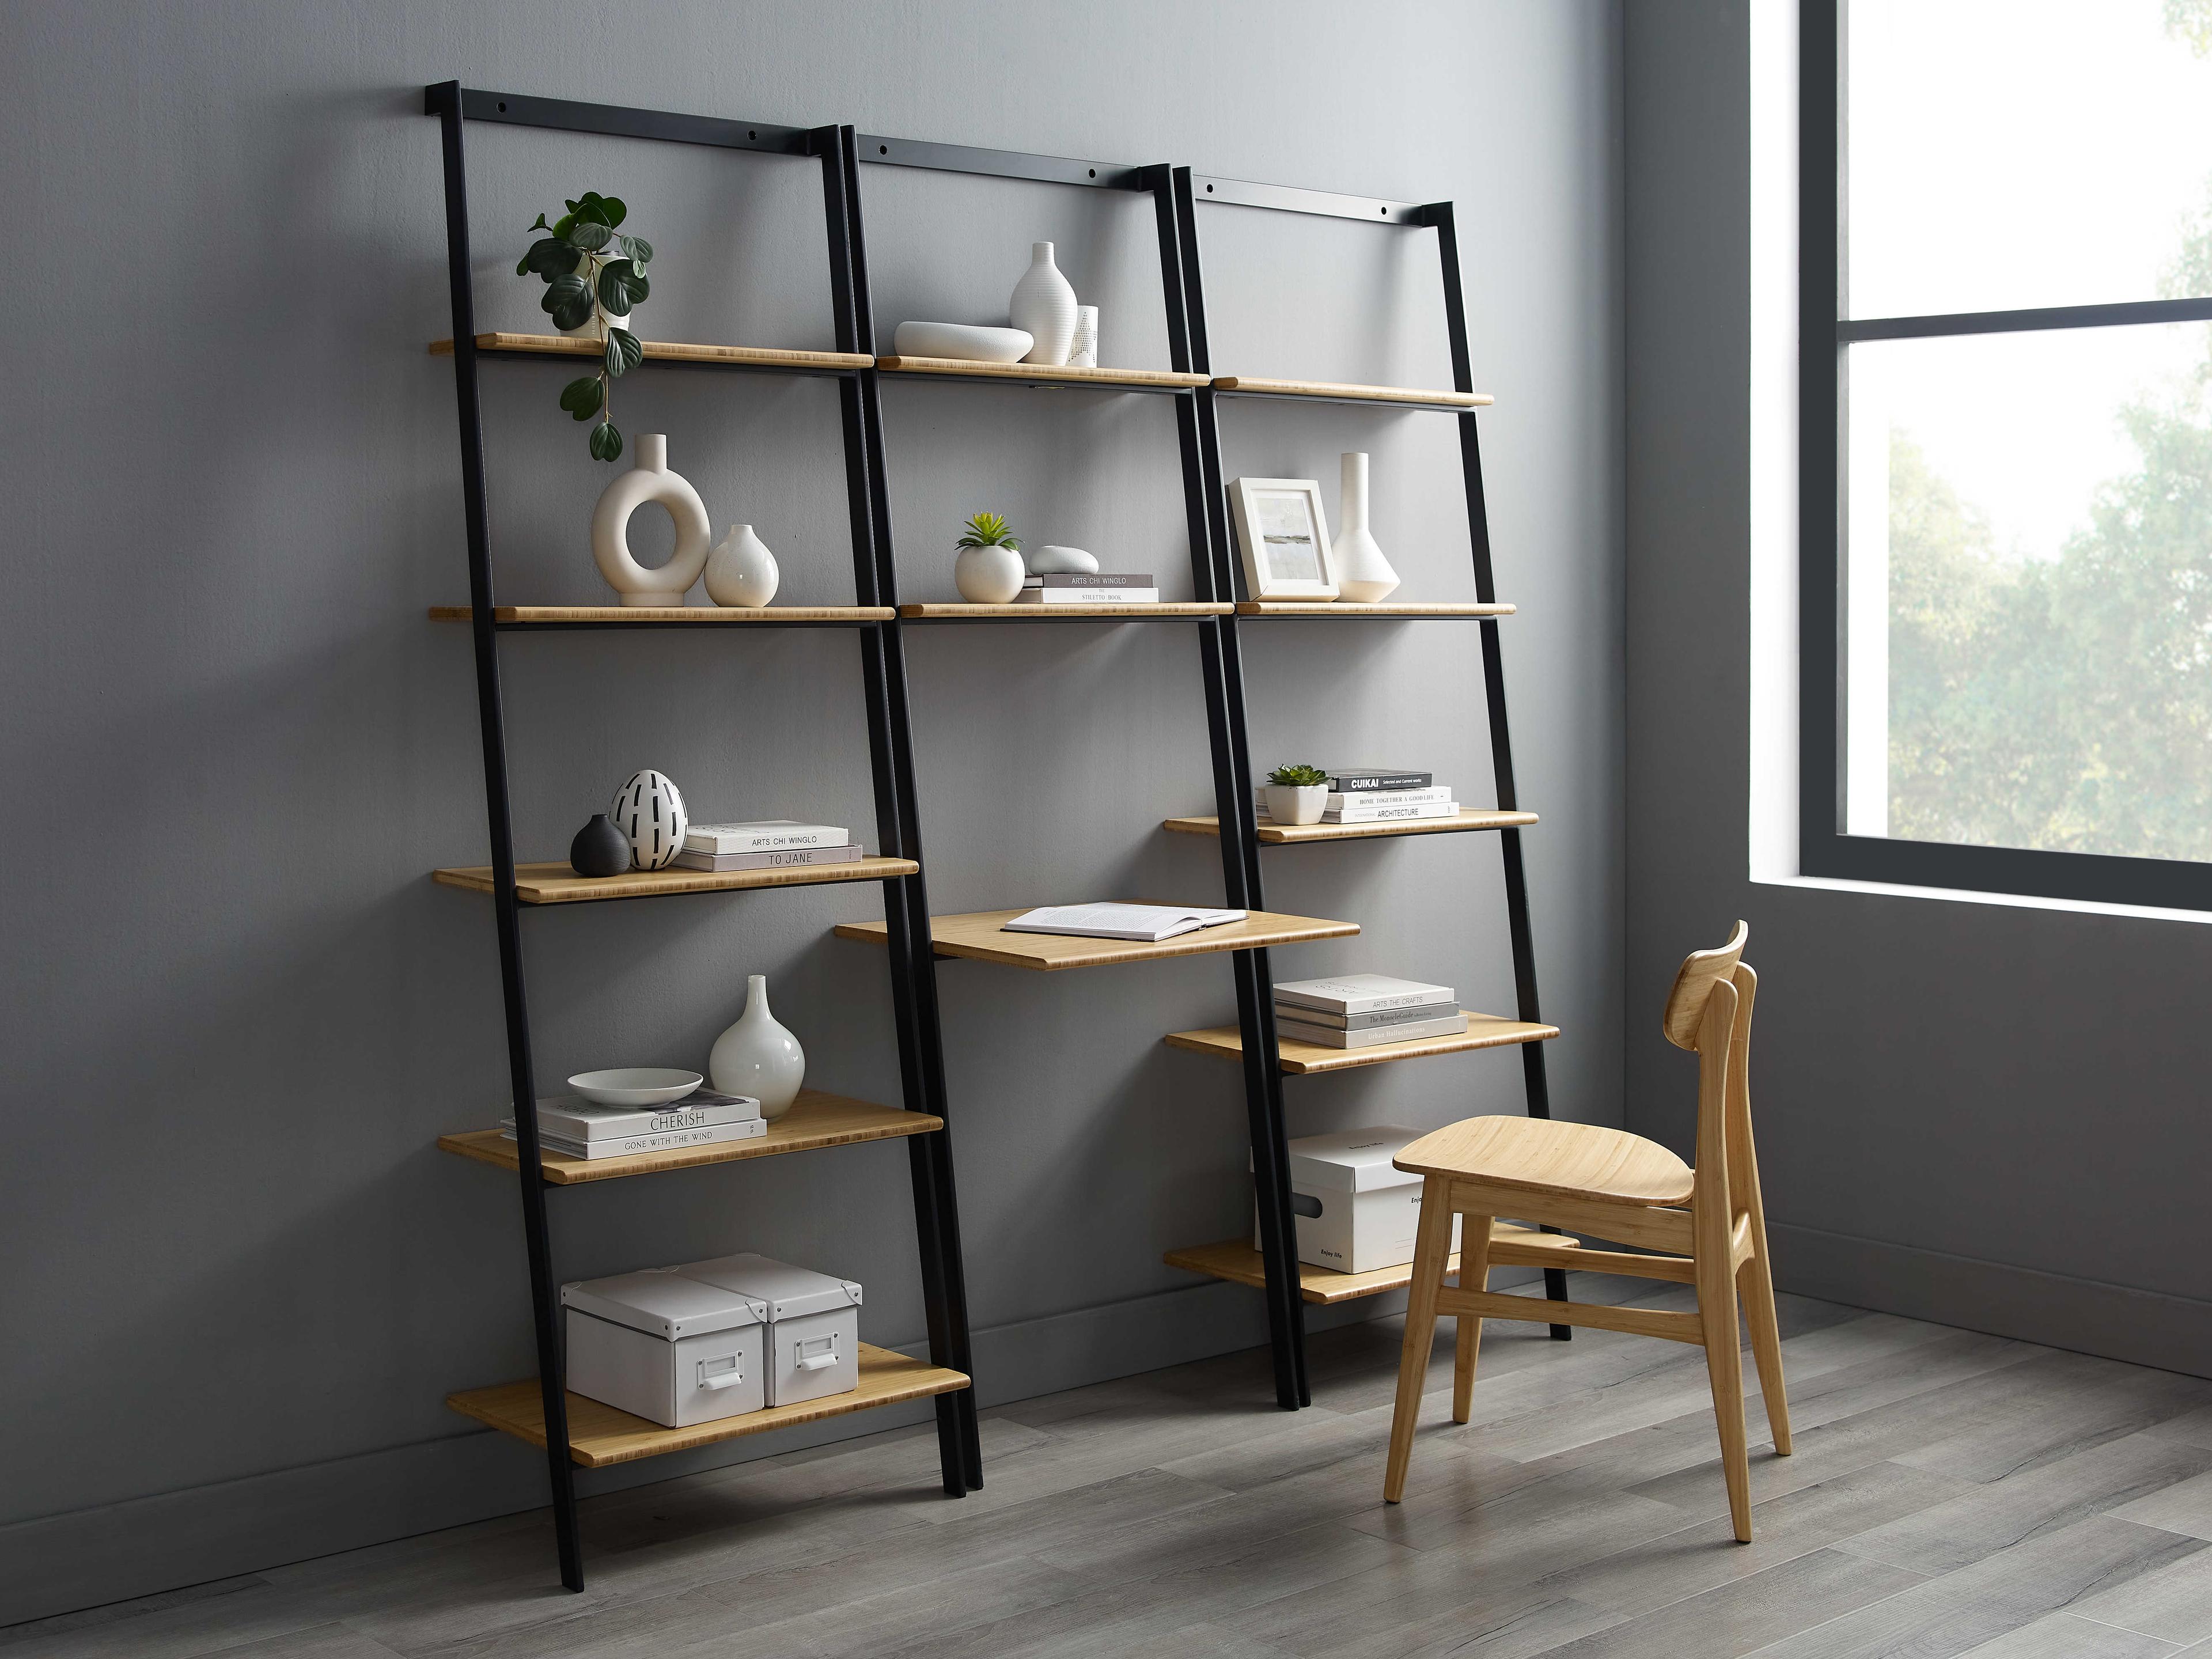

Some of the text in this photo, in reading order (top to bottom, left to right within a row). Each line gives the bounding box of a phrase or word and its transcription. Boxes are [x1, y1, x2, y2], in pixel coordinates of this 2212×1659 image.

[1351, 778, 1379, 789] CUIKAI
[1377, 809, 1419, 817] ARCHITECTURE
[752, 838, 770, 846] ARTS
[789, 836, 817, 844] WINGLO
[769, 853, 813, 865] TO JANE
[1402, 997, 1423, 1005] CRAFTS
[1387, 1027, 1425, 1037] Hallucinations
[650, 1112, 705, 1131] CHERISH
[624, 1131, 713, 1150] GONE WITH THE WIND
